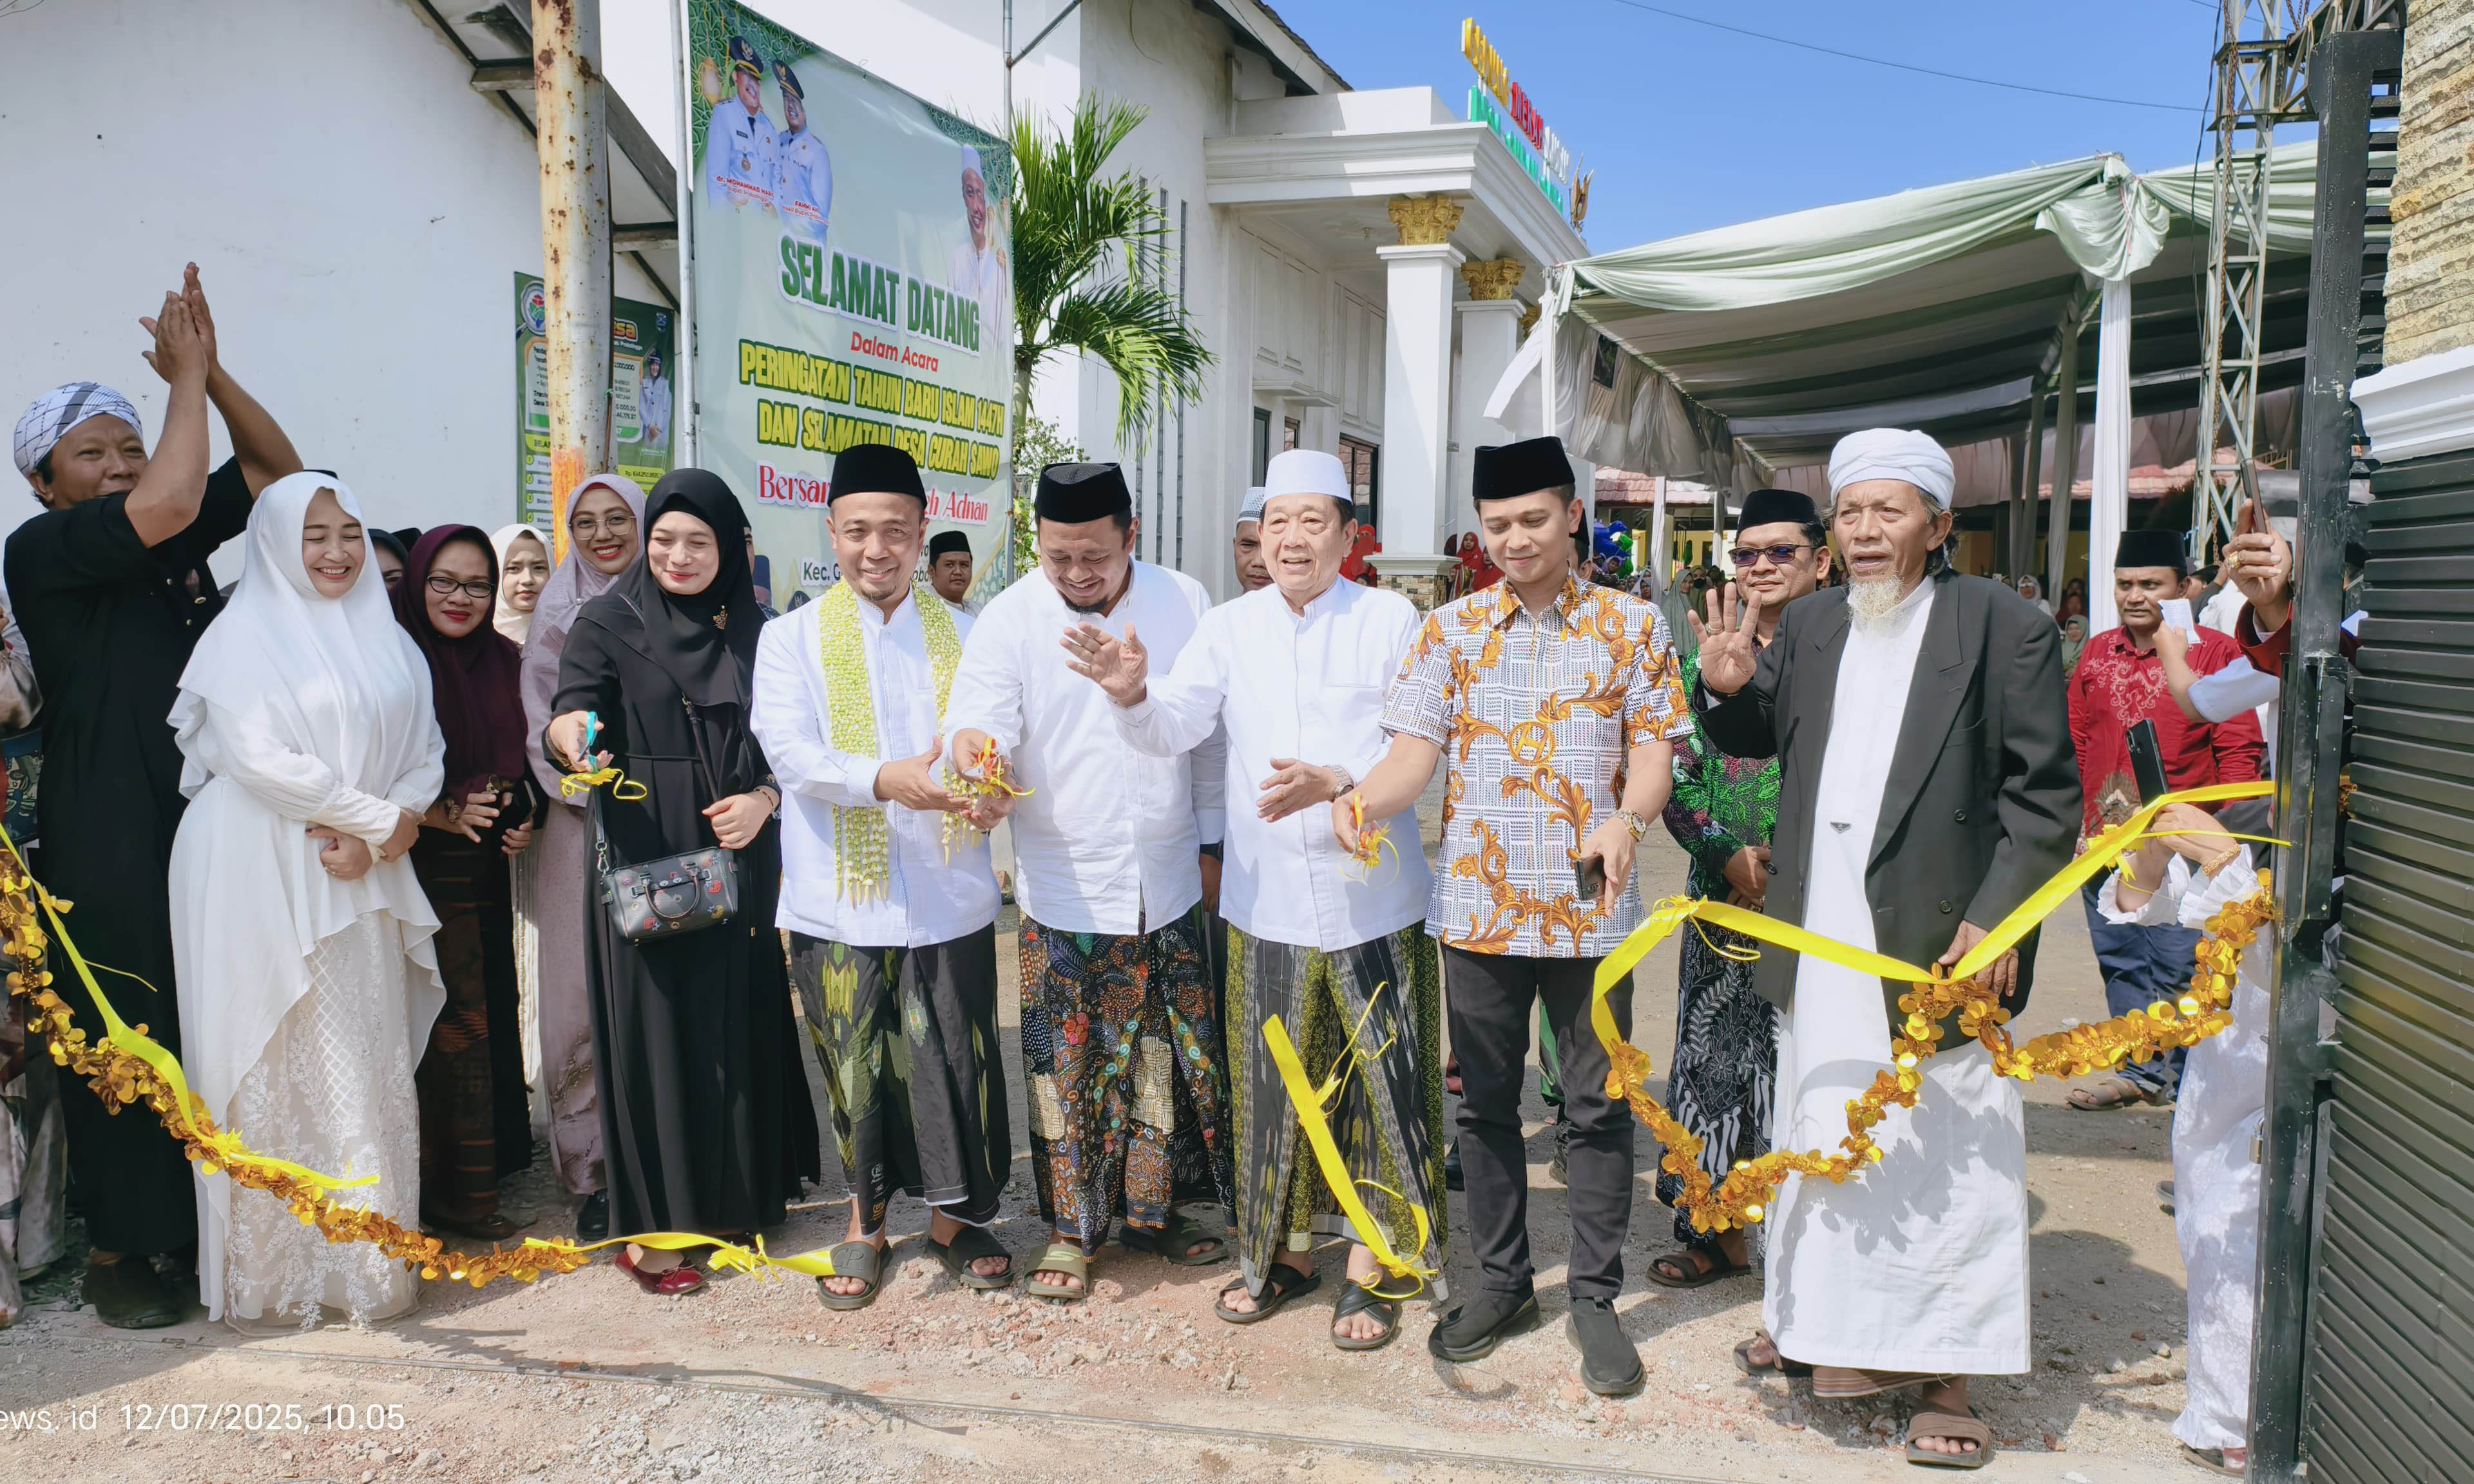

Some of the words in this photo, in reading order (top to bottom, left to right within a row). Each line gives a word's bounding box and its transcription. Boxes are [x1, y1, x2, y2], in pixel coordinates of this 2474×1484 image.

[779, 233, 900, 327] SELAMAT
[906, 272, 980, 354] DATANG
[850, 331, 898, 362] Dalam
[901, 346, 939, 372] Acara
[740, 339, 850, 404] PERINGATAN
[854, 365, 902, 415] TAHUN
[903, 377, 940, 423] BARU
[941, 386, 975, 431] ISLAM
[977, 397, 1004, 437] 1447H
[758, 399, 799, 448] DAN
[928, 432, 969, 475] CURAH
[970, 441, 999, 480] SAWO
[943, 491, 989, 520] Adnan
[803, 562, 830, 581] Kec.
